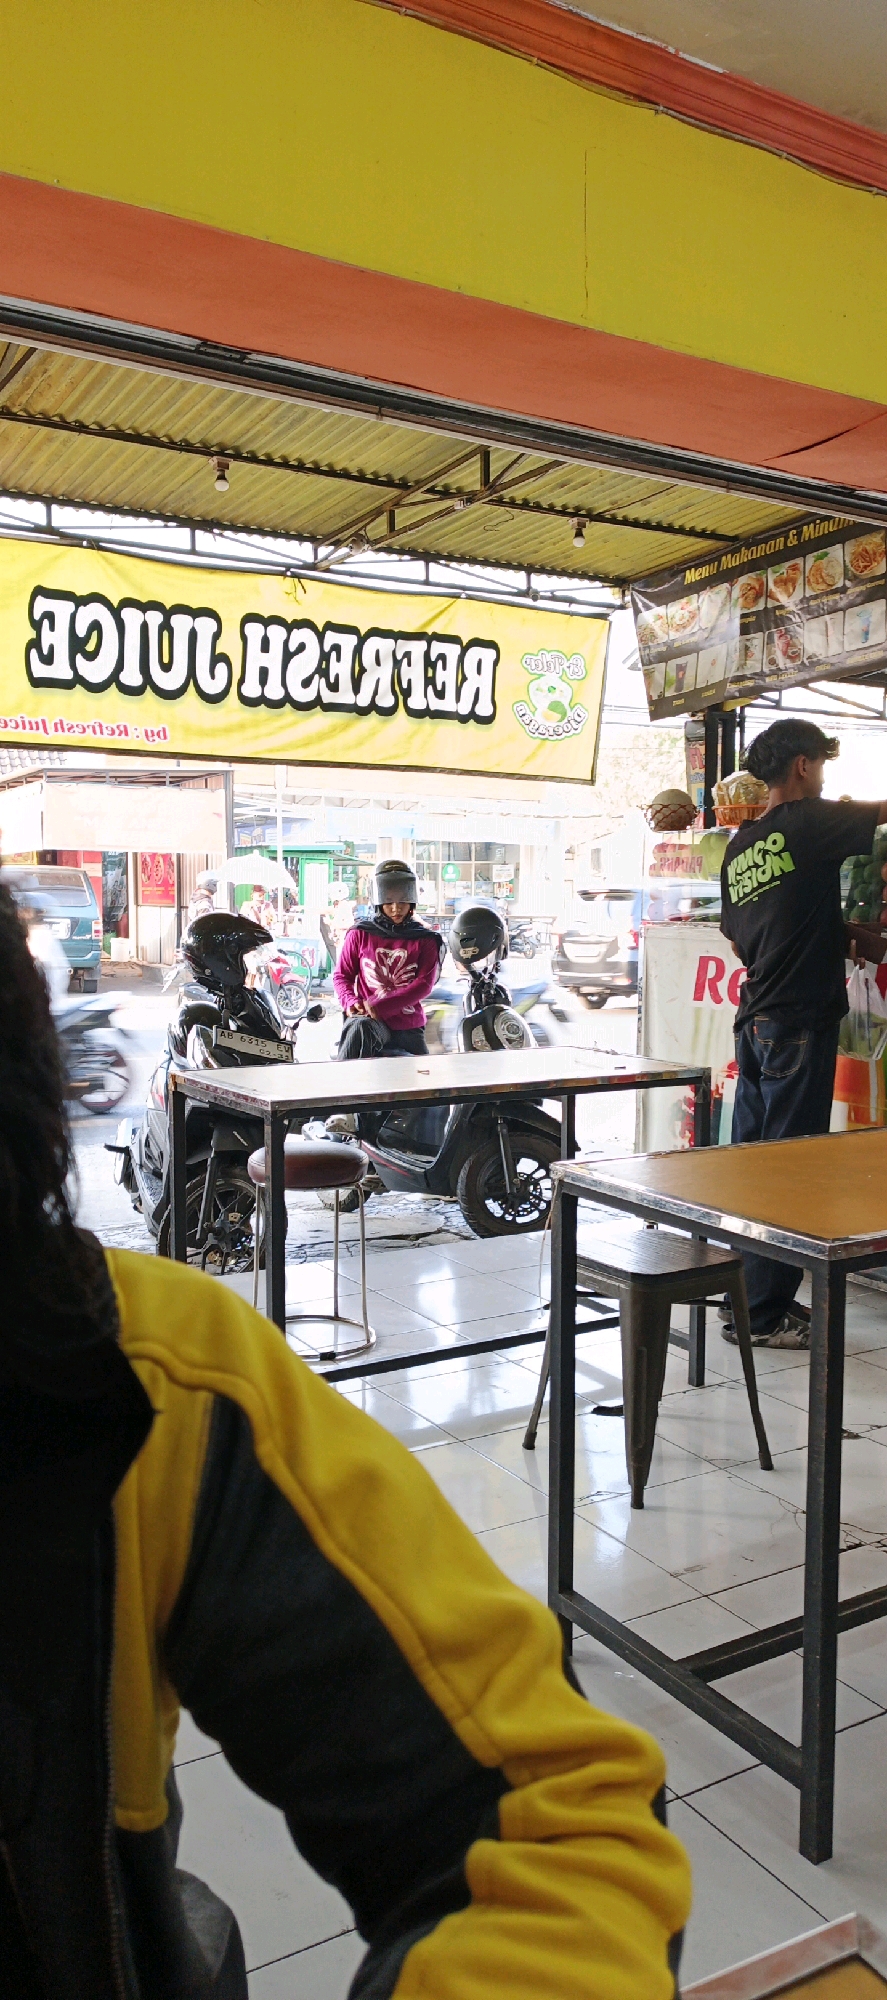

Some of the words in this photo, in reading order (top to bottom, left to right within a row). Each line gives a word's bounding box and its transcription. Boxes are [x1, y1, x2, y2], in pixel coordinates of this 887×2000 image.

[684, 561, 718, 586] Menu
[720, 537, 784, 570] Makanan
[787, 529, 798, 547] &
[801, 517, 858, 542] Minum
[728, 851, 796, 904] VISION
[693, 955, 751, 1007] Re
[220, 1030, 234, 1040] AB
[240, 1035, 267, 1048] 6315
